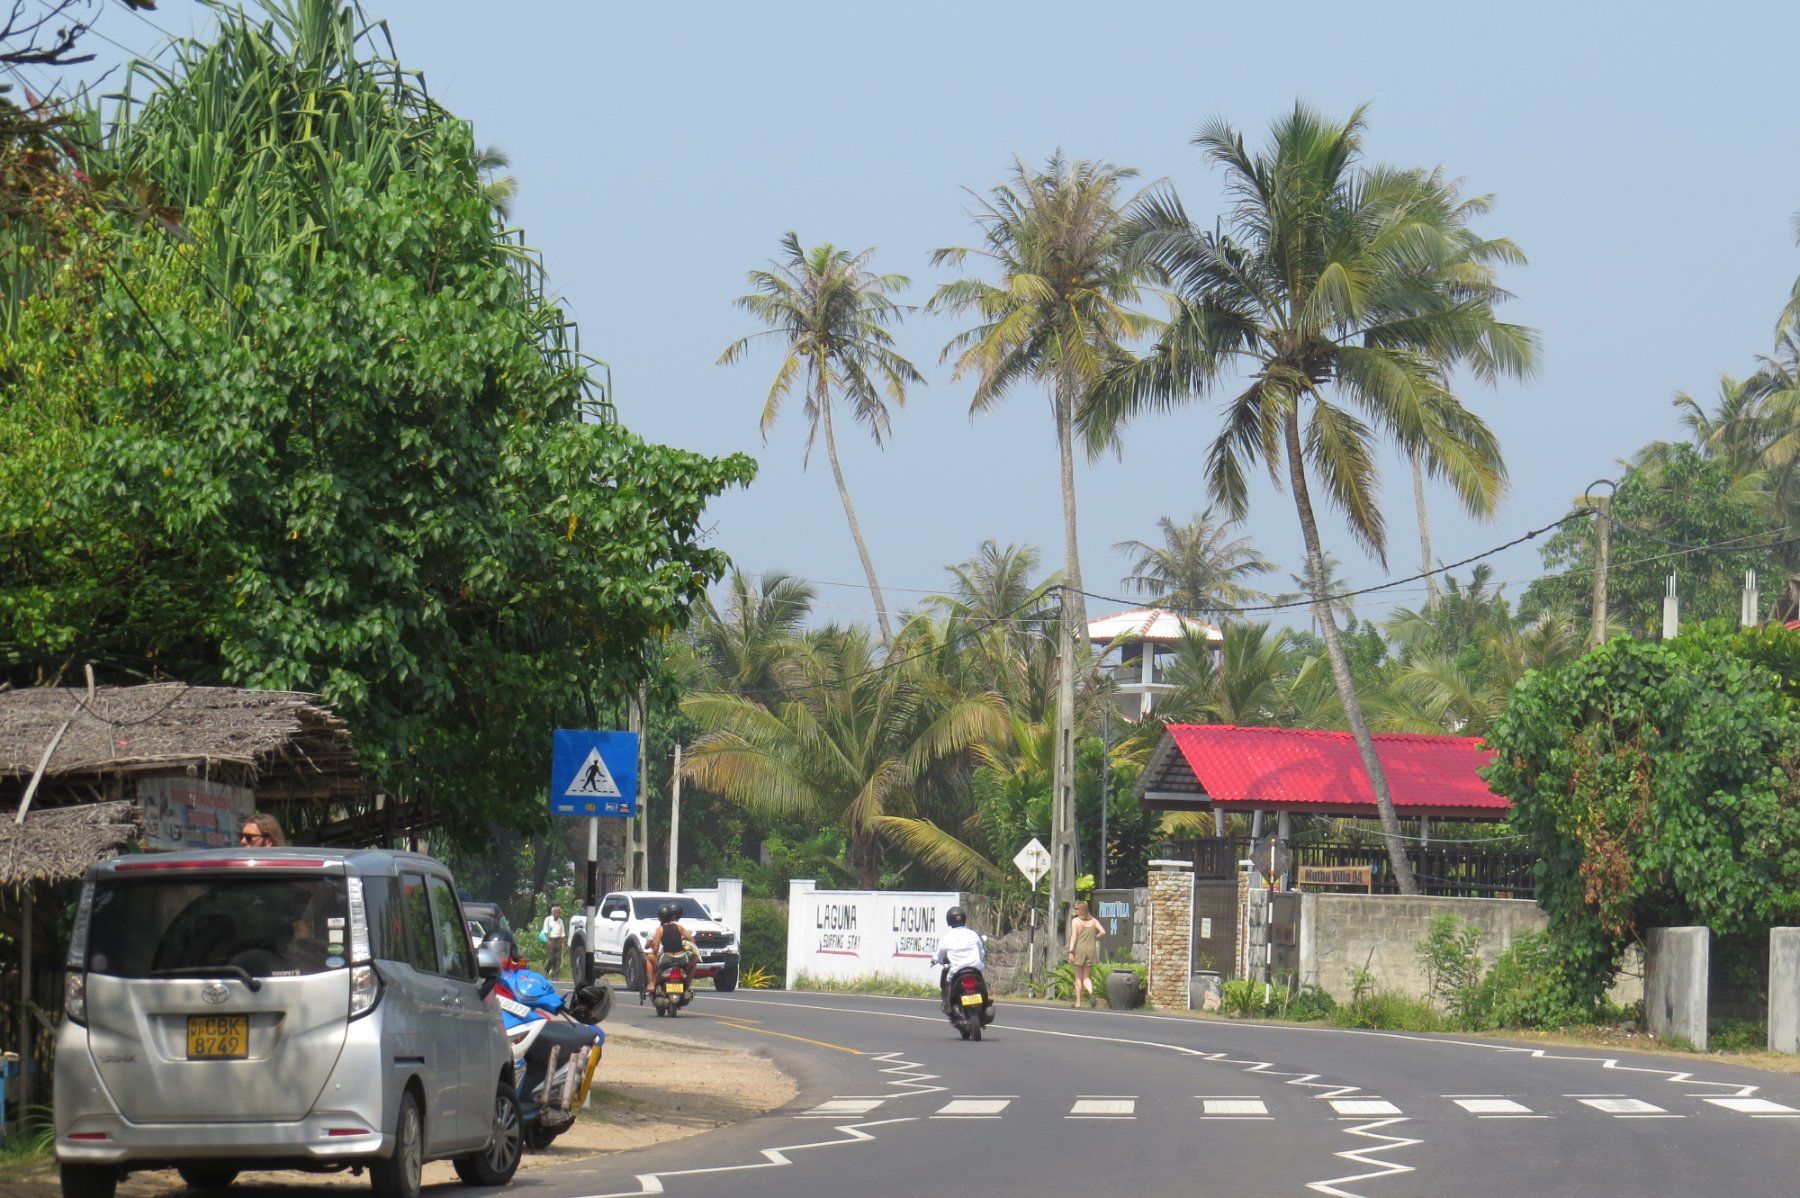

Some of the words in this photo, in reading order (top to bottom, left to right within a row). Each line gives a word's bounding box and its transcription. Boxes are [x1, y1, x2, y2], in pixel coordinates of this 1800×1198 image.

[817, 904, 857, 930] LAGUNA
[893, 906, 935, 933] LAGUNA
[822, 933, 844, 949] SURFING
[847, 935, 861, 951] STAY
[900, 936, 922, 952] SURFING
[206, 1017, 241, 1036] CBK
[195, 1036, 240, 1054] 8749
